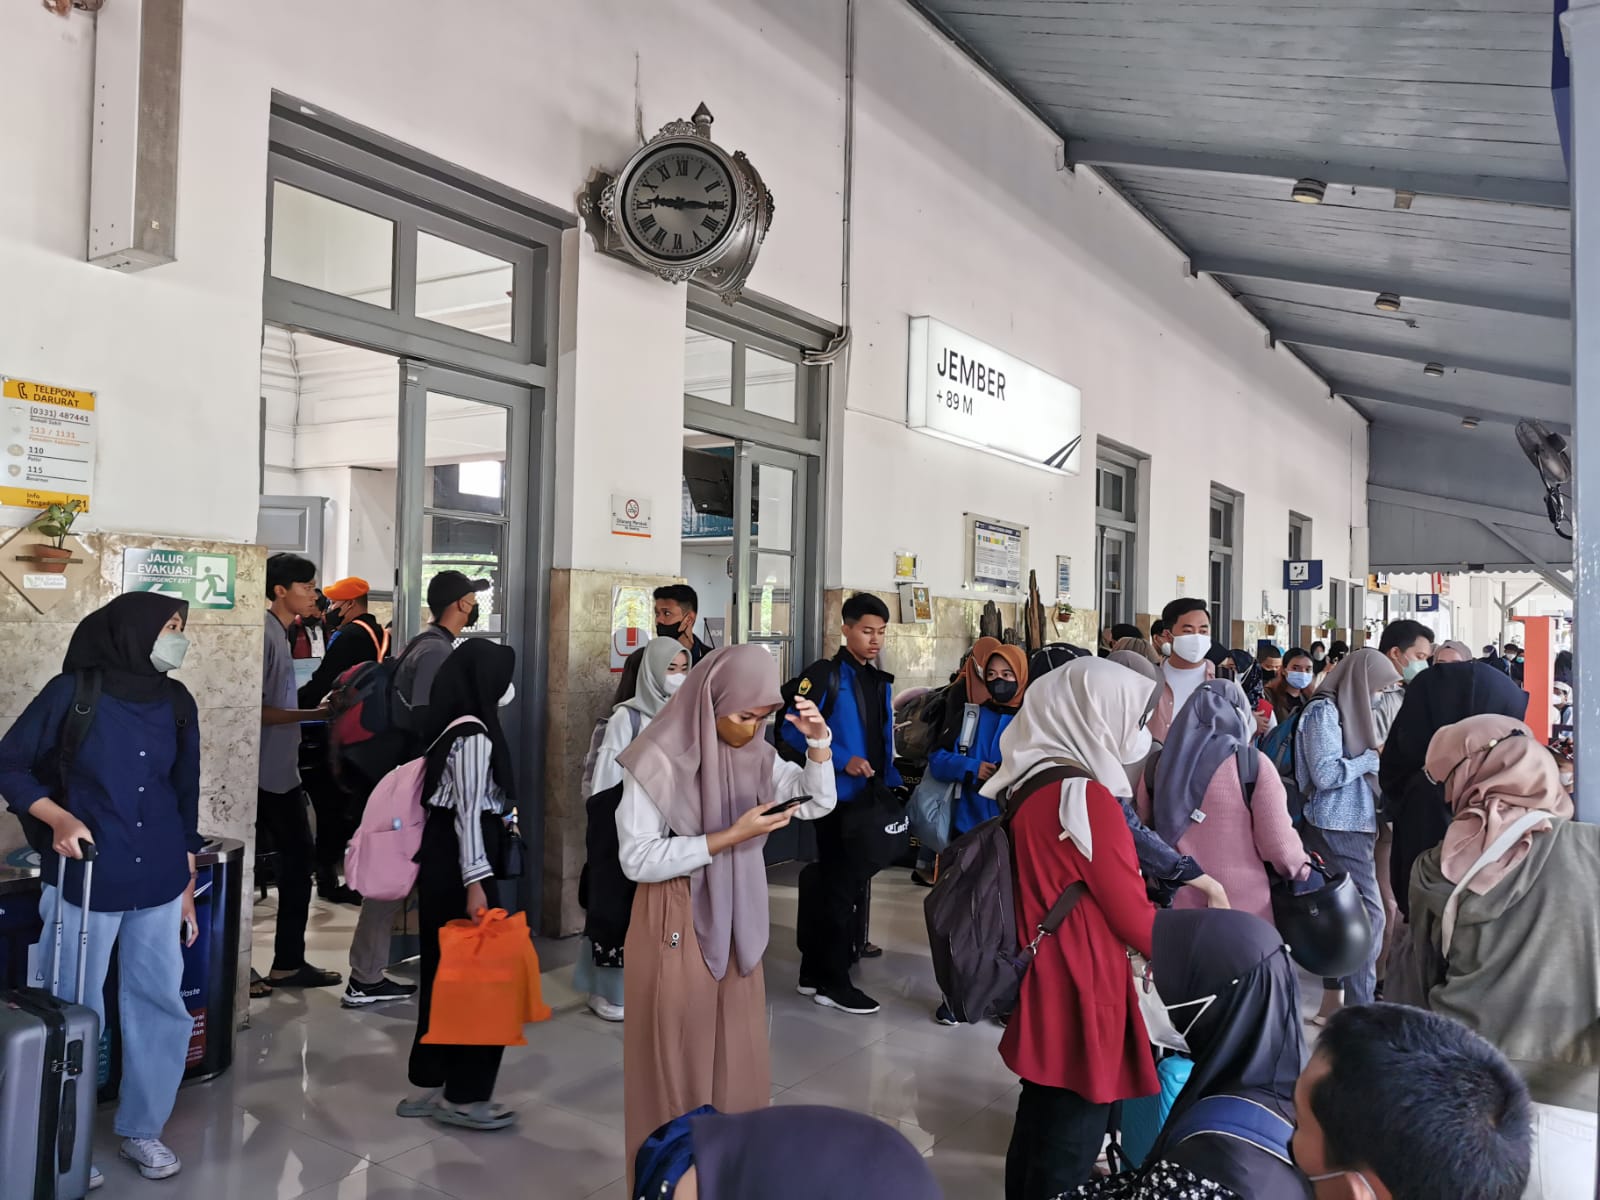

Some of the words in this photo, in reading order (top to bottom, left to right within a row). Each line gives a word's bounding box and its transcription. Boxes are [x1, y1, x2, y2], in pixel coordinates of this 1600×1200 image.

[656, 163, 671, 182] XI
[676, 159, 688, 175] XII
[641, 179, 659, 193] X
[704, 180, 721, 193] II
[936, 347, 1007, 401] JEMBER
[34, 384, 76, 399] TELEPON
[33, 393, 80, 408] DARURAT
[945, 390, 960, 410] 89
[962, 395, 973, 416] M
[30, 406, 57, 418] (0331)
[28, 446, 44, 455] 110
[28, 465, 43, 474] 115
[147, 553, 185, 565] JALUR
[137, 563, 194, 577] EVAKUASI
[177, 577, 192, 585] EXIT
